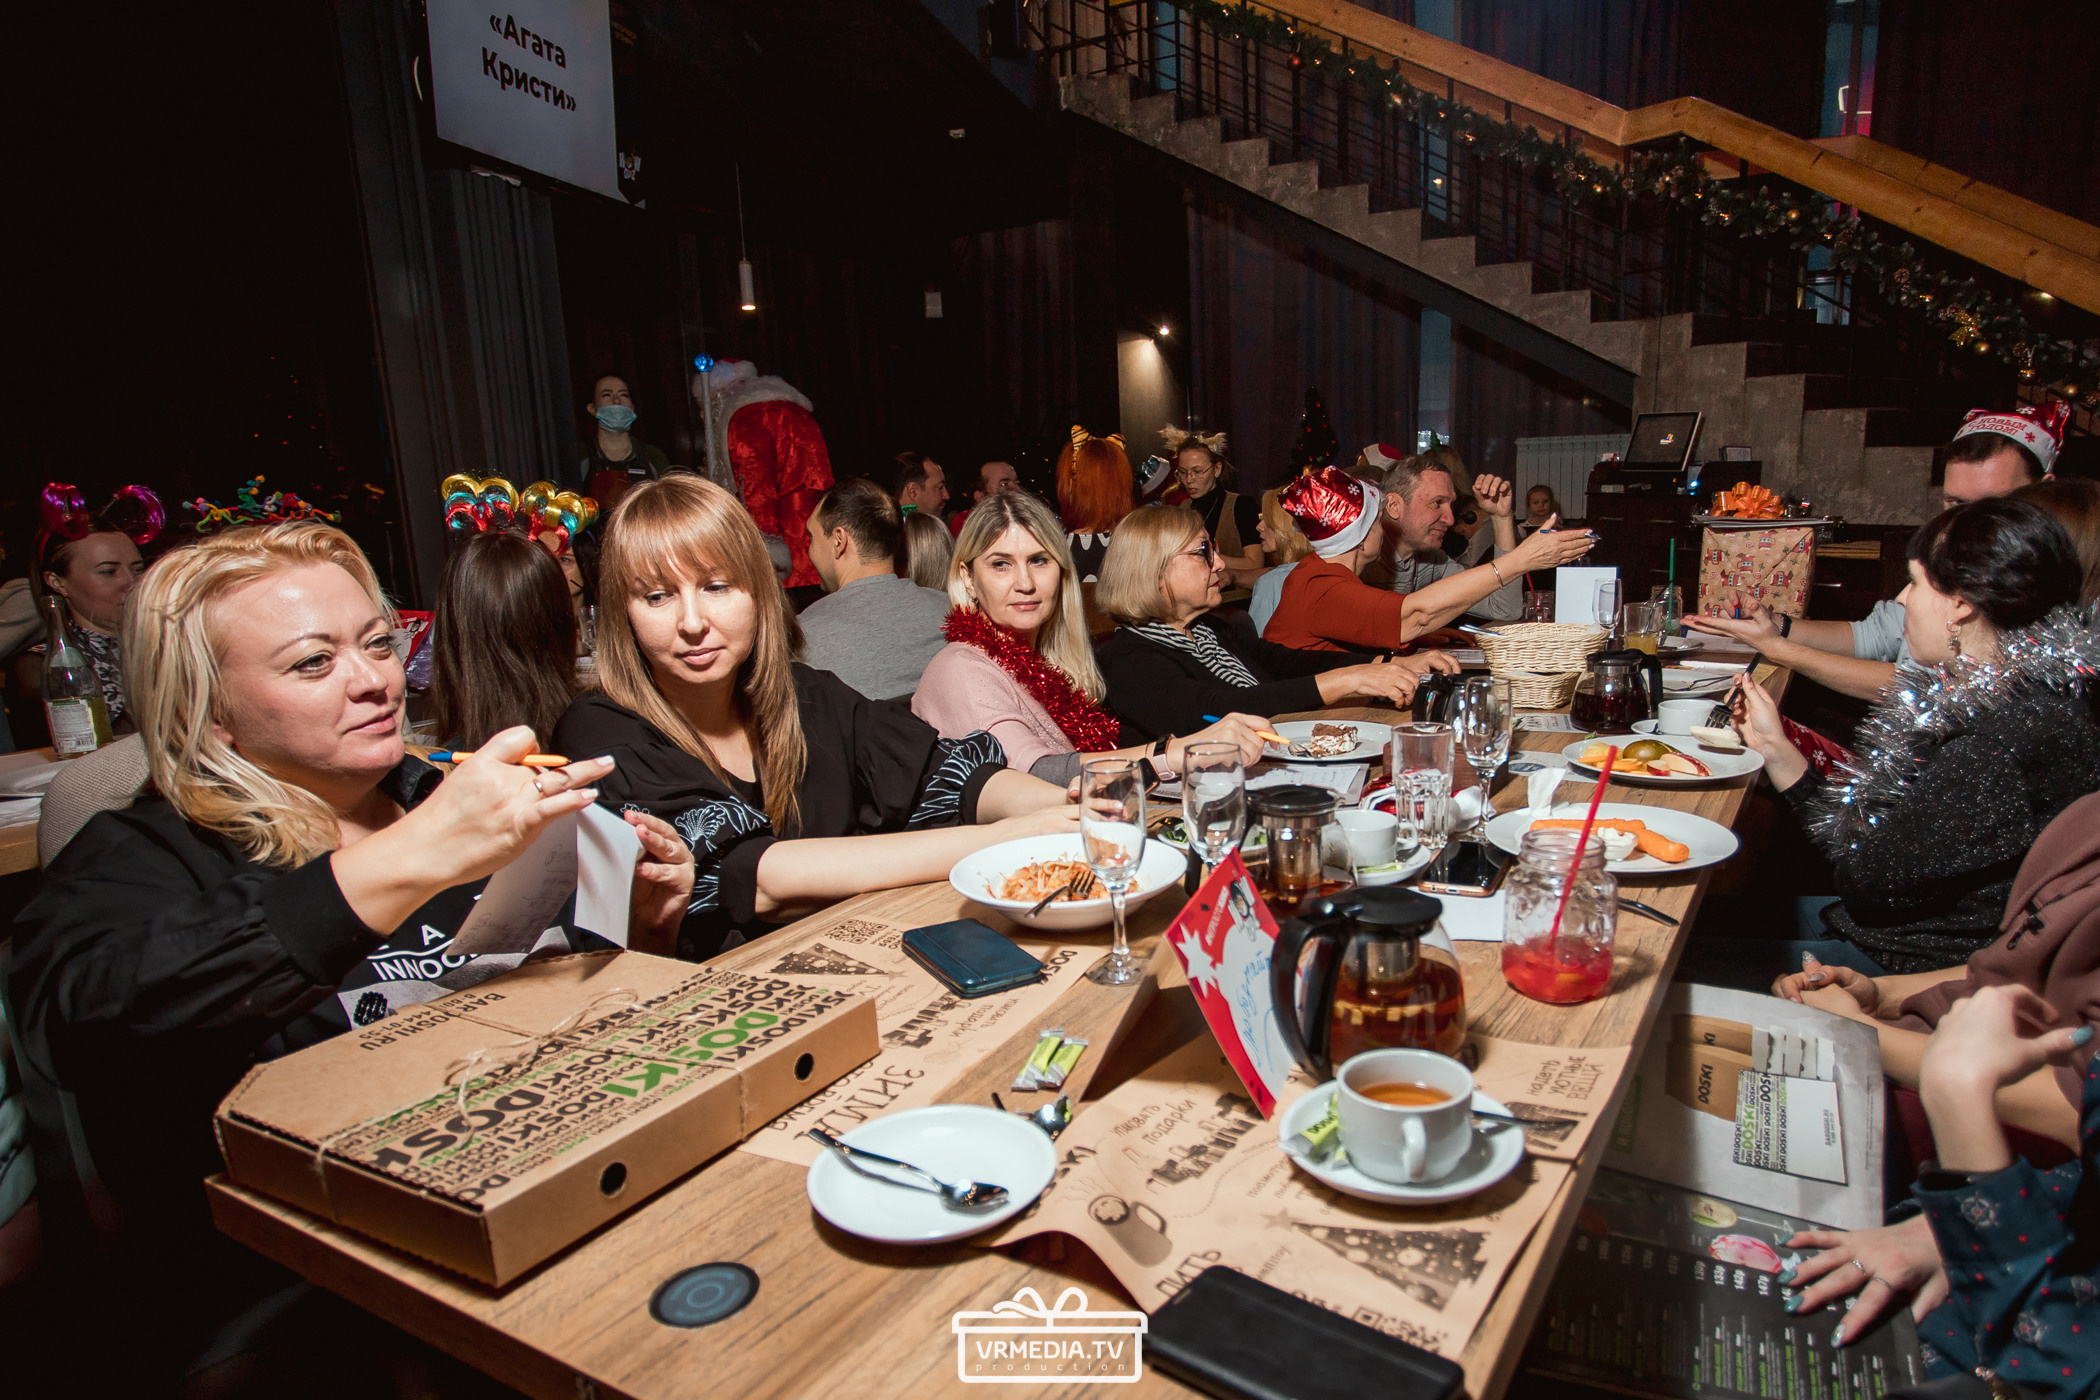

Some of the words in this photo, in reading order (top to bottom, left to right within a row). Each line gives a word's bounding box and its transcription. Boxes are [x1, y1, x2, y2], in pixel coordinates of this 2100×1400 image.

[489, 14, 567, 69] «Агата
[481, 46, 576, 112] Кристи»
[371, 953, 479, 981] INNOC
[794, 1063, 925, 1142] ЗИМА
[1698, 1063, 1714, 1105] DOSKI
[493, 1089, 611, 1146] DOSKI
[1742, 1104, 1755, 1149] DOSKI
